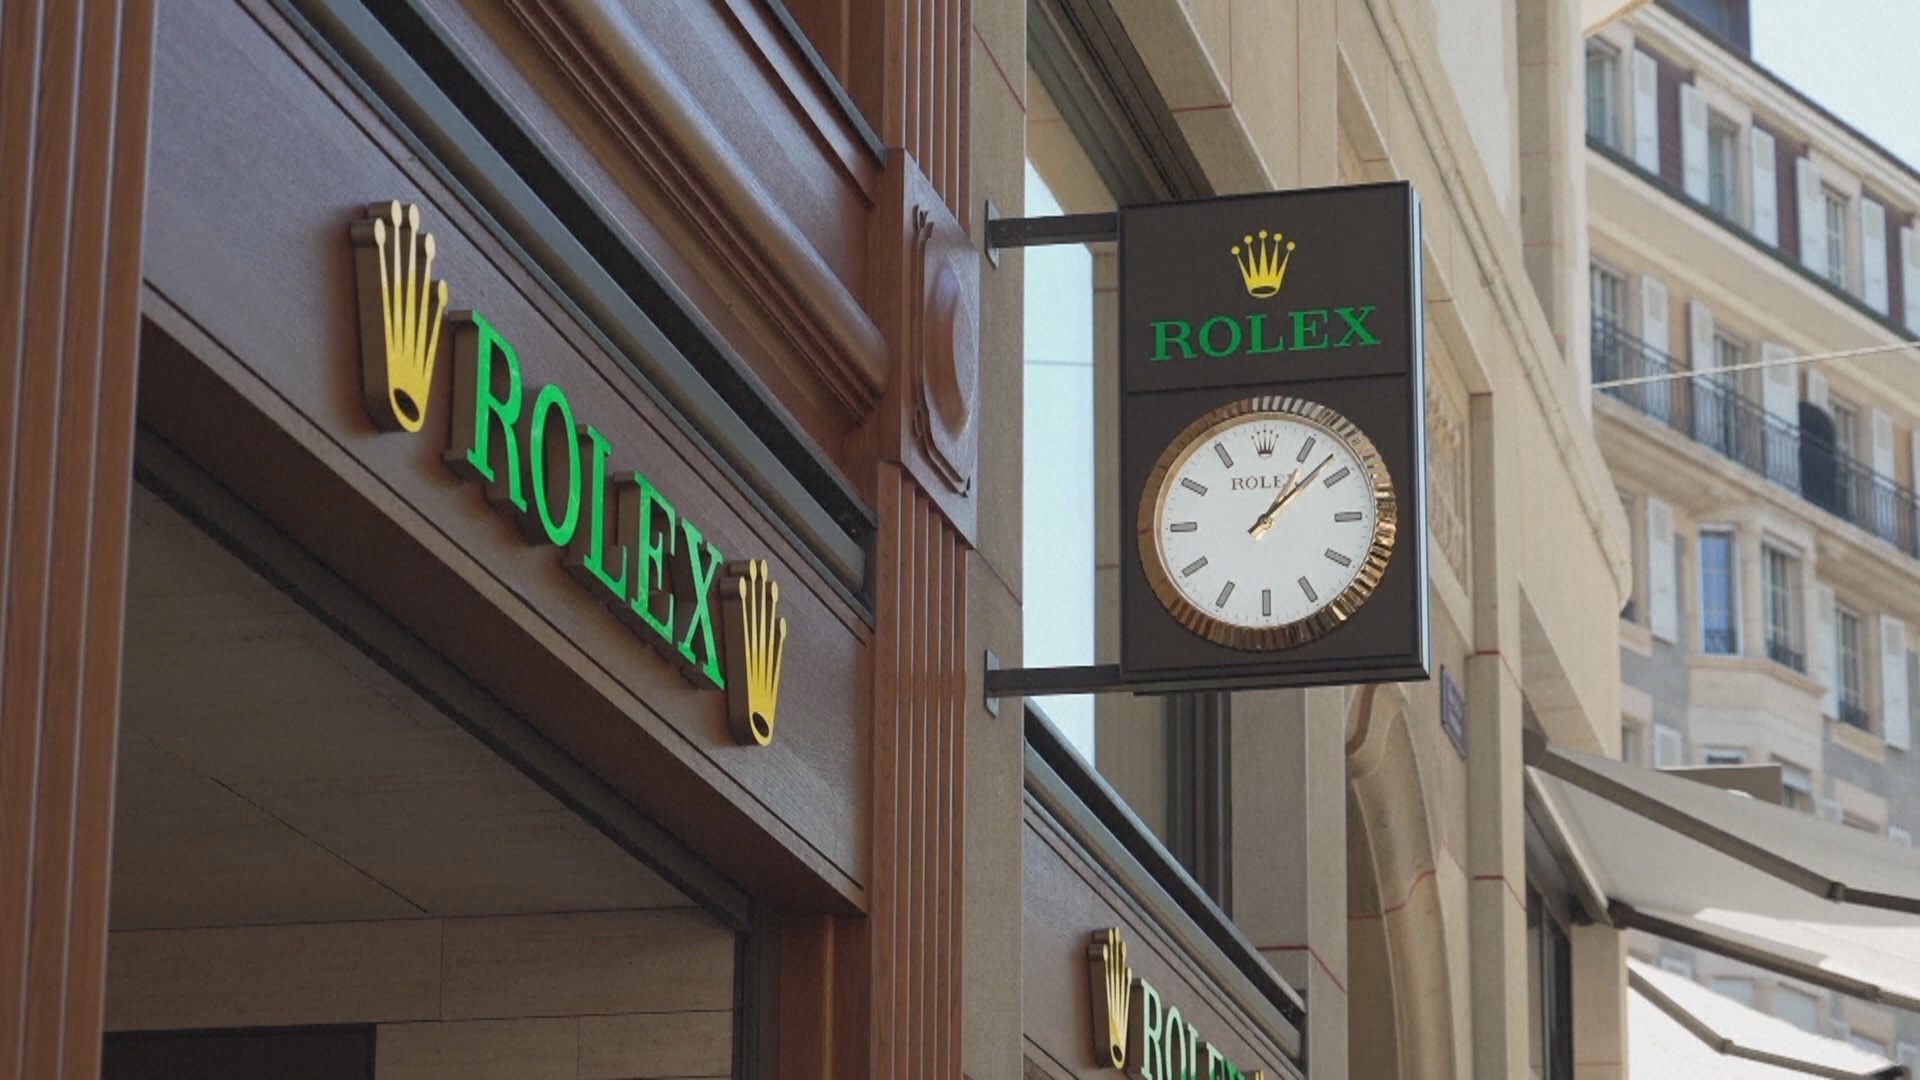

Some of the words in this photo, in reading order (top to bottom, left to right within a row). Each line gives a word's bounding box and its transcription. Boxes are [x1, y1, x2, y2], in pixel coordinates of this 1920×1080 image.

[1150, 303, 1381, 362] ROLEX
[466, 308, 726, 690] ROLEX
[1231, 473, 1300, 490] ROLE
